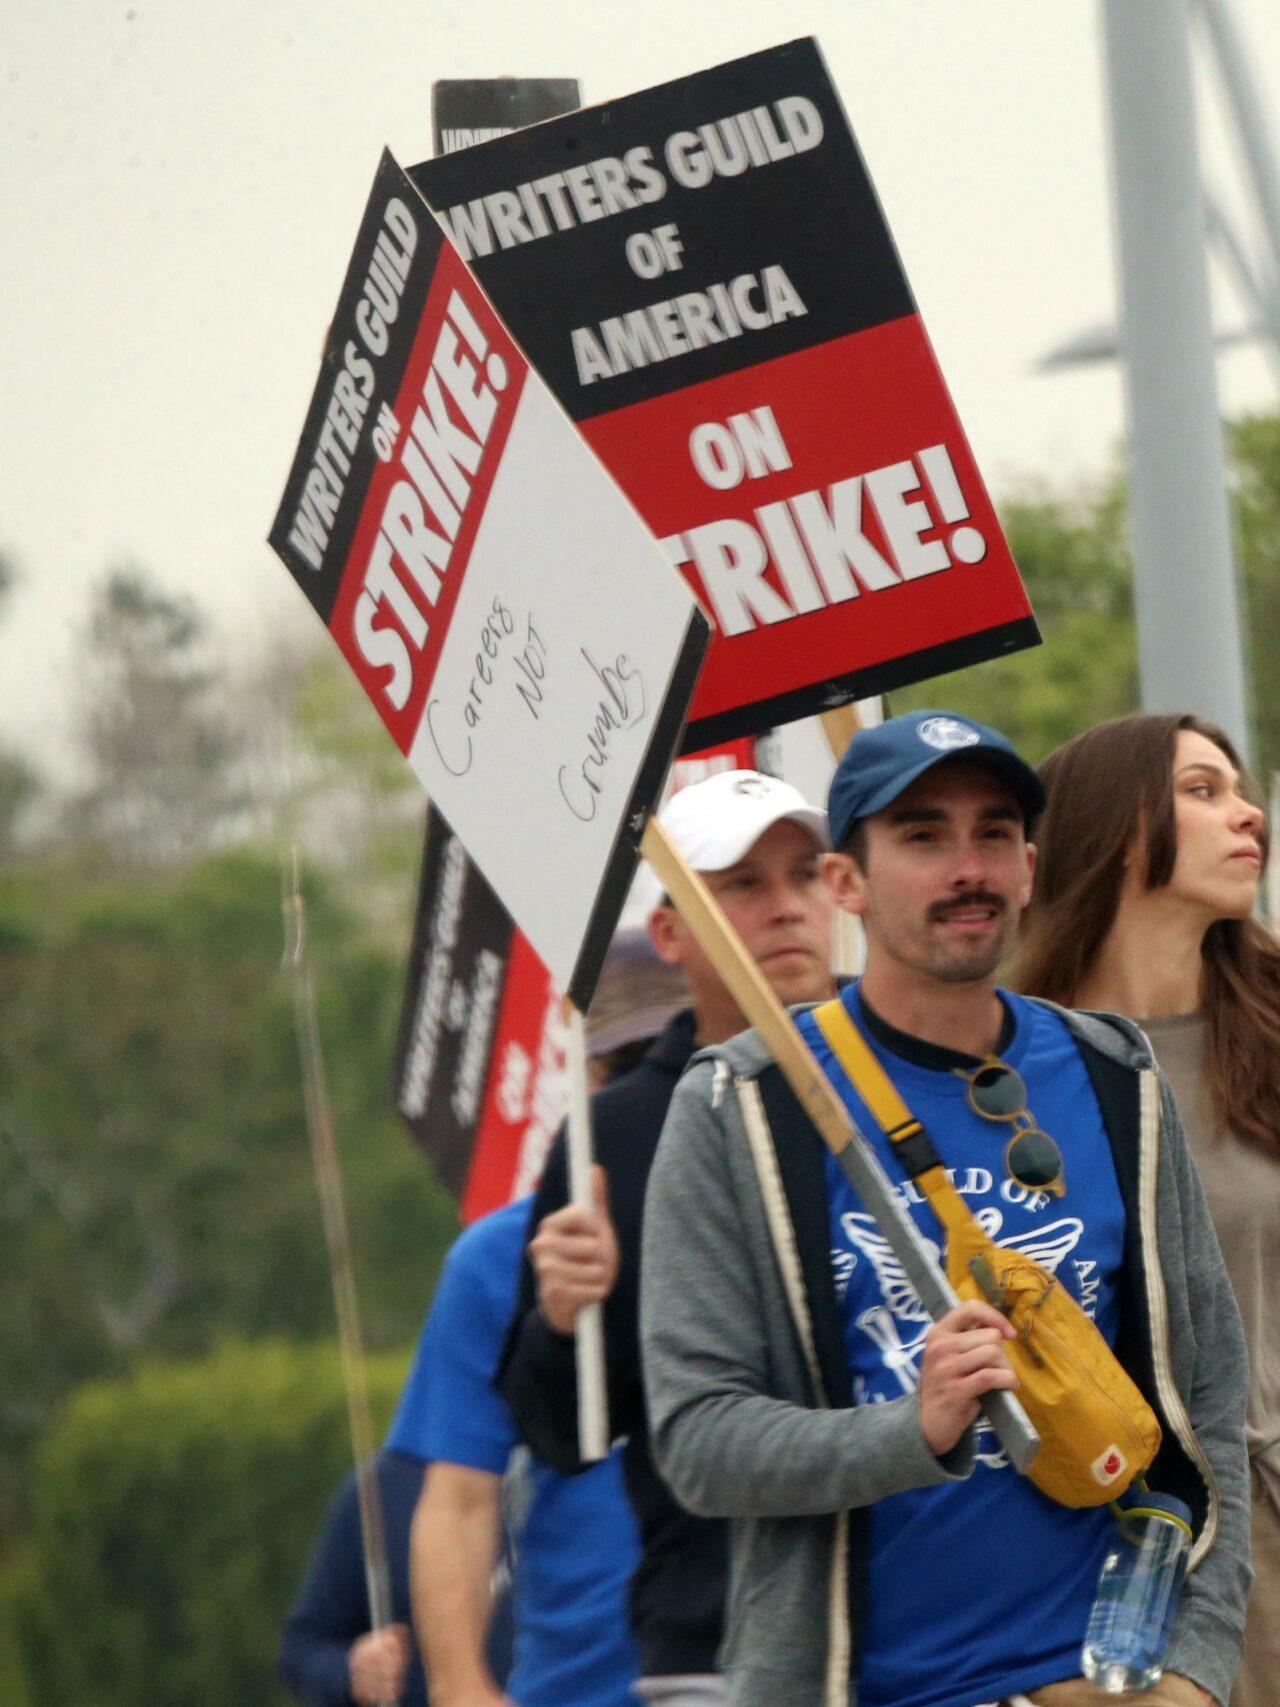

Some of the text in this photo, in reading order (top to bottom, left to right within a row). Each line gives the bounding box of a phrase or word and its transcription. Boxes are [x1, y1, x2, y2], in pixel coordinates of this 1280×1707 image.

[431, 96, 824, 263] WRITERS GUILD
[625, 223, 684, 280] OF
[286, 197, 418, 572] WRITERS GUILD
[571, 264, 809, 386] AMERICA
[353, 287, 510, 712] STRIKE!
[372, 400, 402, 463] ON
[688, 404, 793, 491] ON
[655, 443, 987, 638] RIKE!
[427, 594, 515, 776] Careers
[558, 646, 646, 822] Crumbs
